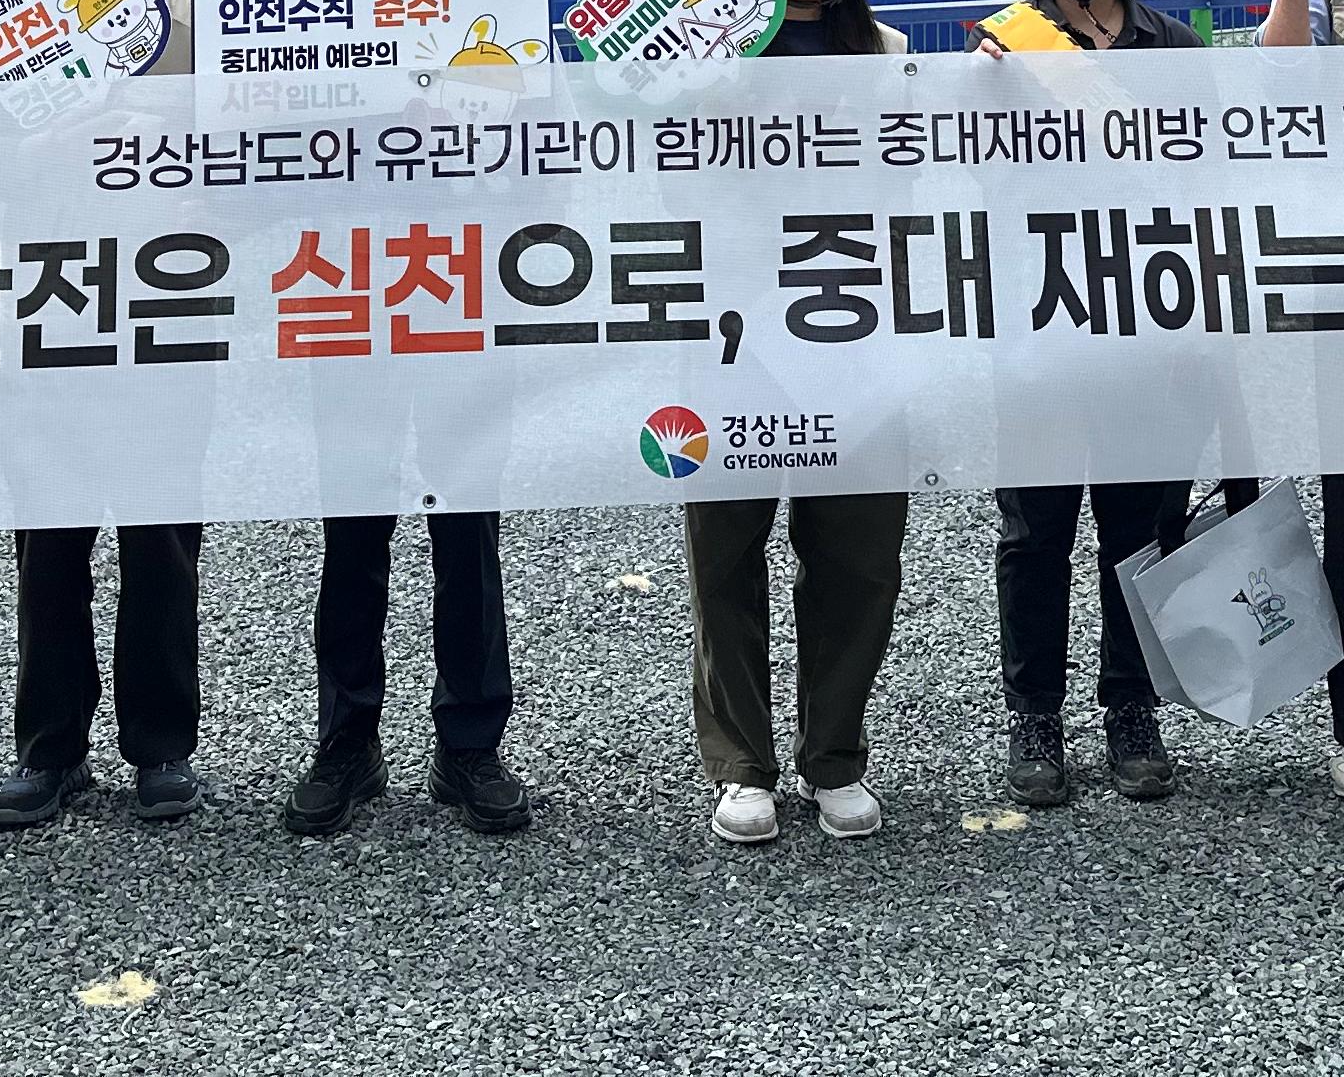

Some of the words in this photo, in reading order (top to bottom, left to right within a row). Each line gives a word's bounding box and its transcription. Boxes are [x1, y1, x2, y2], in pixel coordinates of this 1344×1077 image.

[26, 39, 74, 74] 만드는
[220, 44, 319, 74] 중대재해
[325, 40, 399, 71] 예방의
[92, 131, 361, 191] 경상남도와
[375, 118, 637, 182] 유관기관이
[653, 110, 863, 171] 함께하는
[877, 108, 1088, 165] 중대재해
[1102, 105, 1209, 163] 예방
[1220, 104, 1329, 161] 안전
[270, 219, 746, 367] 실천으로,
[776, 210, 997, 345] 중대
[721, 414, 837, 448] 경상남도
[722, 451, 838, 470] GYEONGNAM
